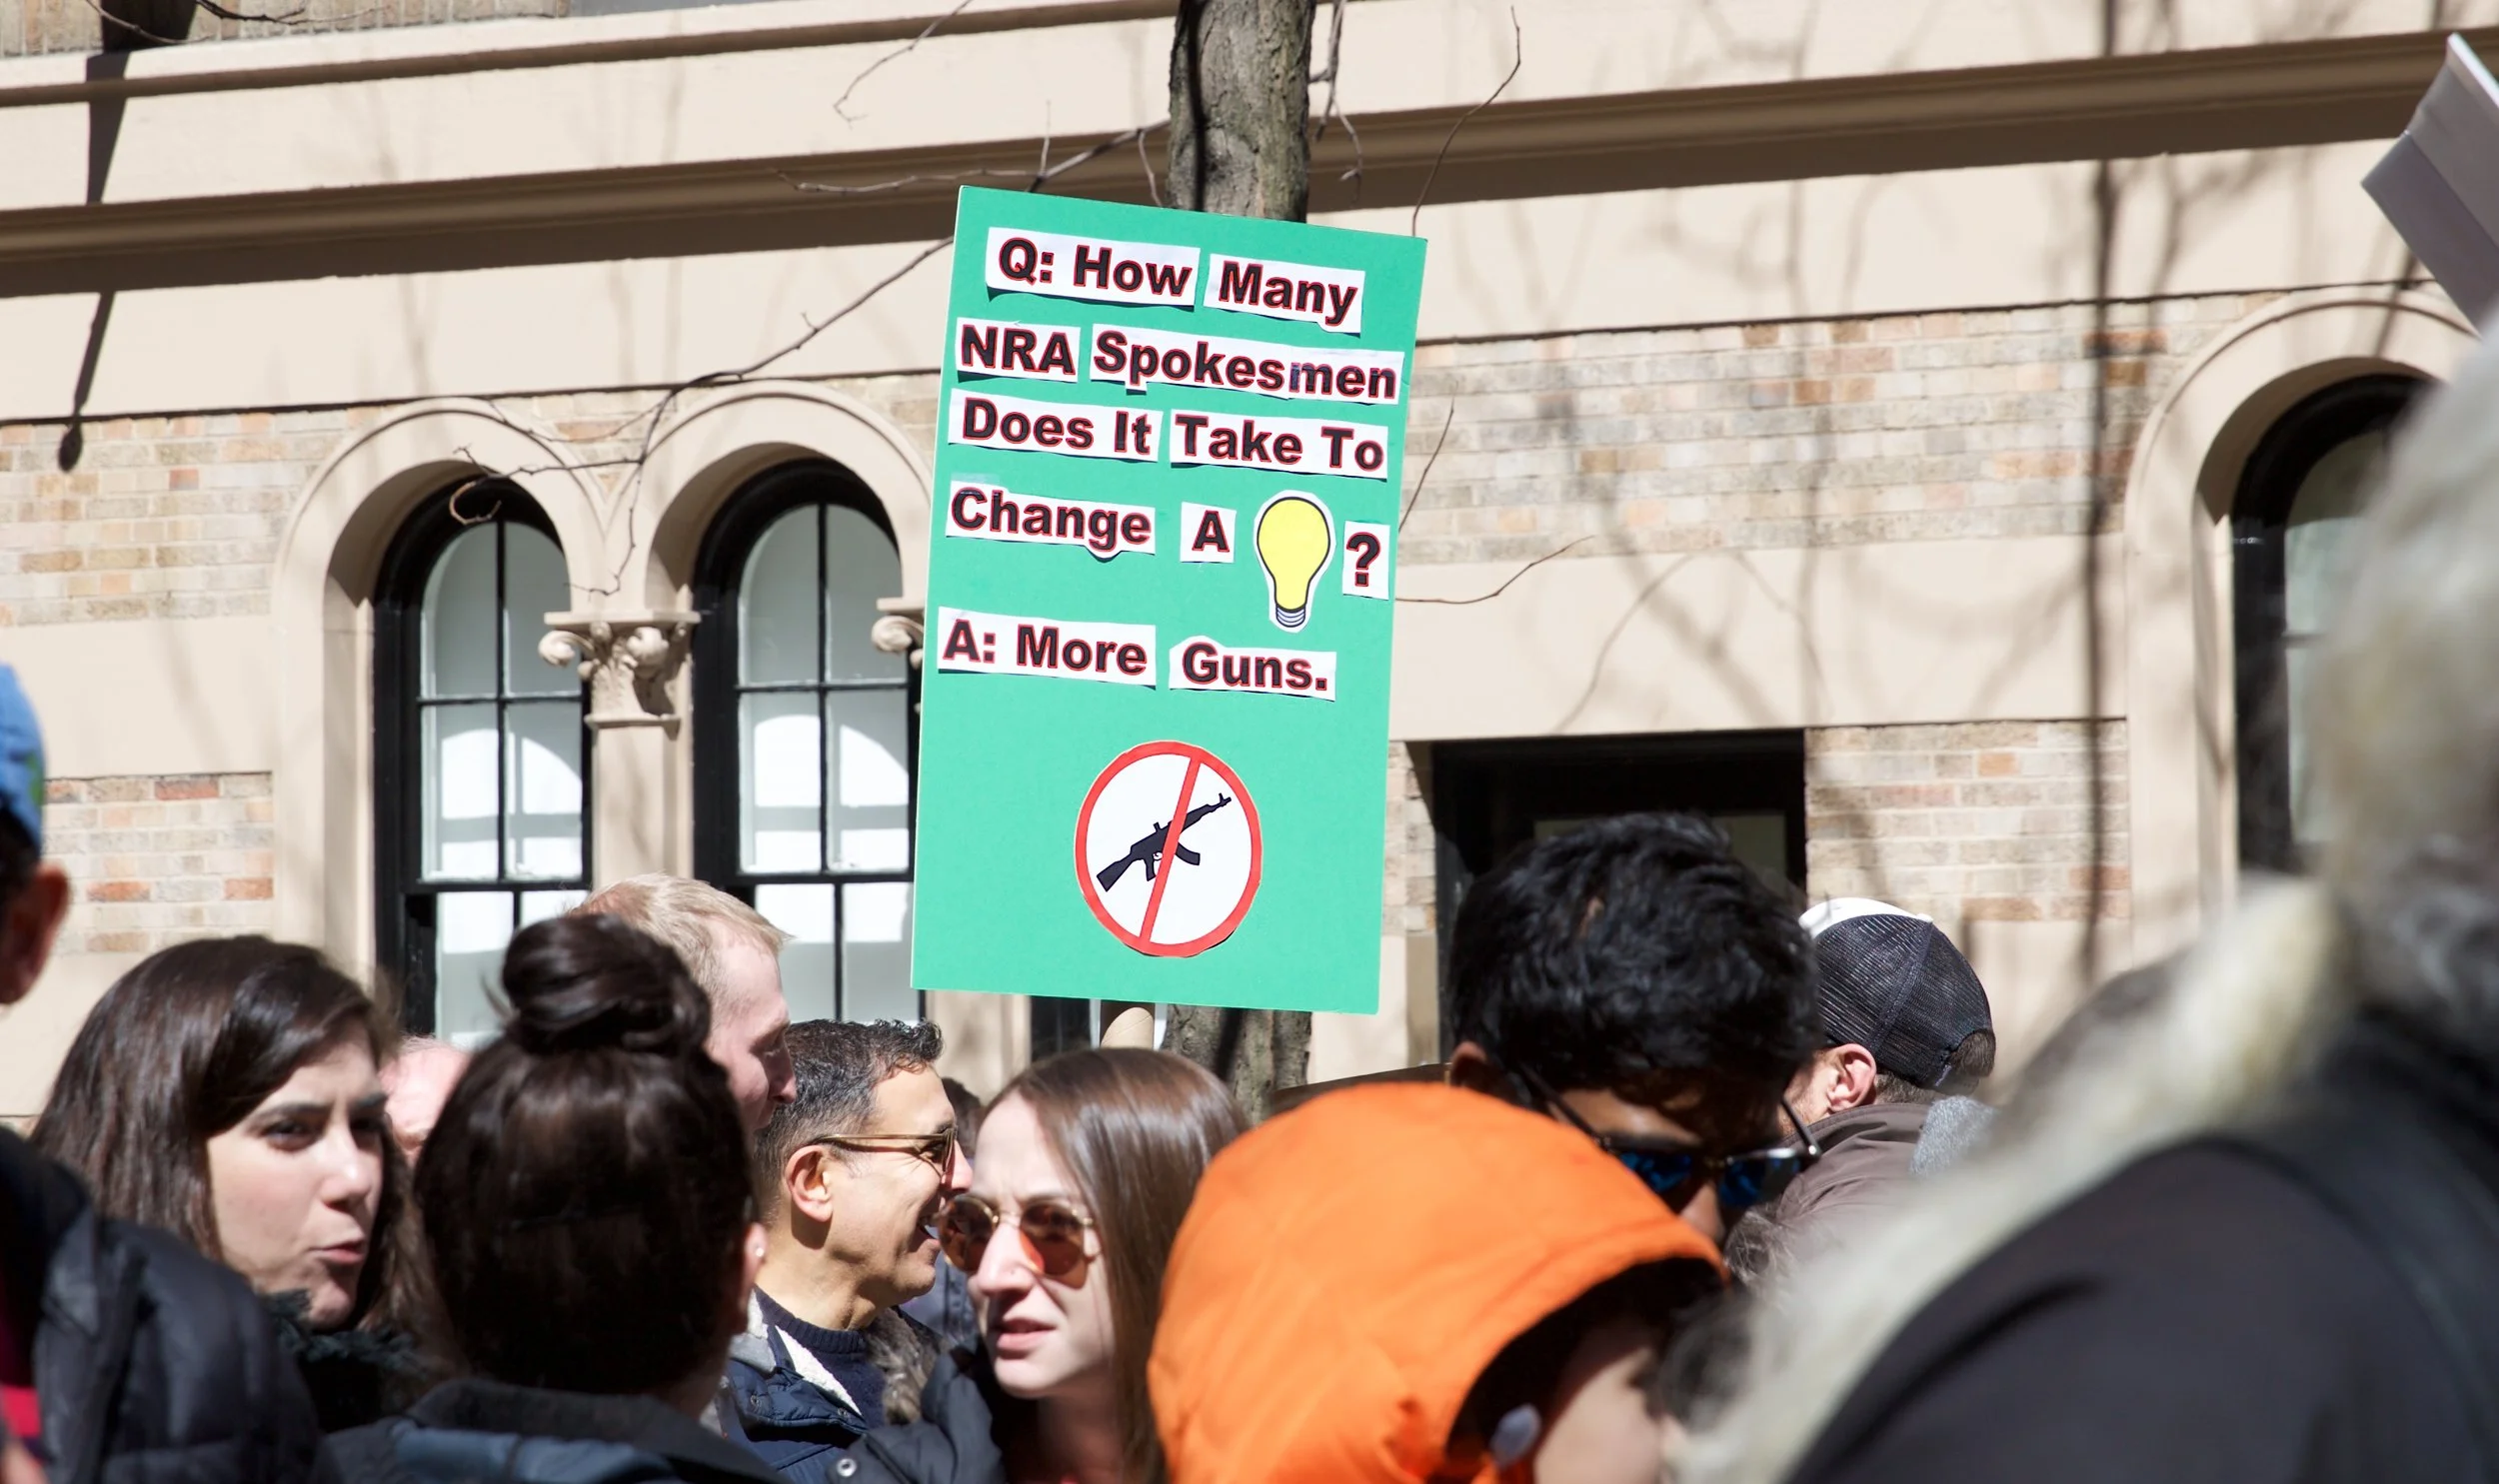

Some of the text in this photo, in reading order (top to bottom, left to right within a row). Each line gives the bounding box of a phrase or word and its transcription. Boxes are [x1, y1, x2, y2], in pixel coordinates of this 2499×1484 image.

[999, 237, 1358, 327] Q: How Many
[961, 324, 1397, 399] NRA Spokesmen
[962, 397, 1383, 472] Does It Take To
[951, 487, 1381, 588] Change A ?
[942, 619, 1327, 691] A: More Guns.
